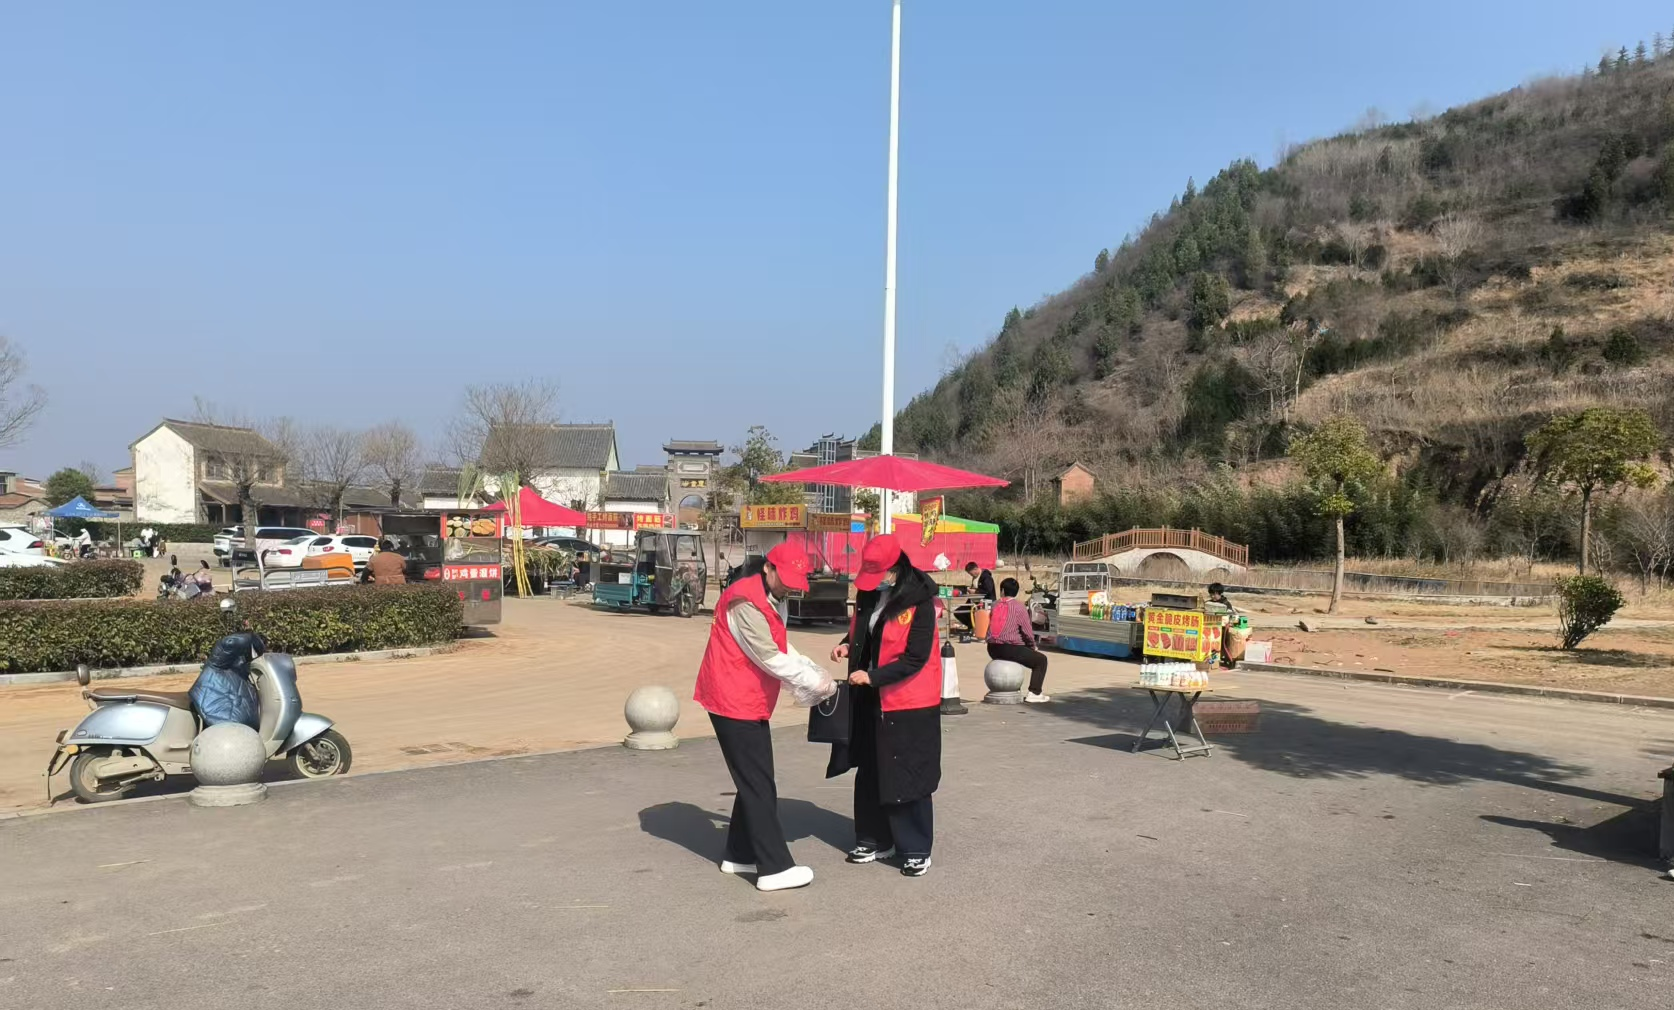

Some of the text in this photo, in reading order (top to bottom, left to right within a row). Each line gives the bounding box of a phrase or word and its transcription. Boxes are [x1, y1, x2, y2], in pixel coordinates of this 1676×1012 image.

[757, 506, 799, 521] 怪味炸鸡
[1148, 612, 1199, 627] 黄金脆皮烤肠
